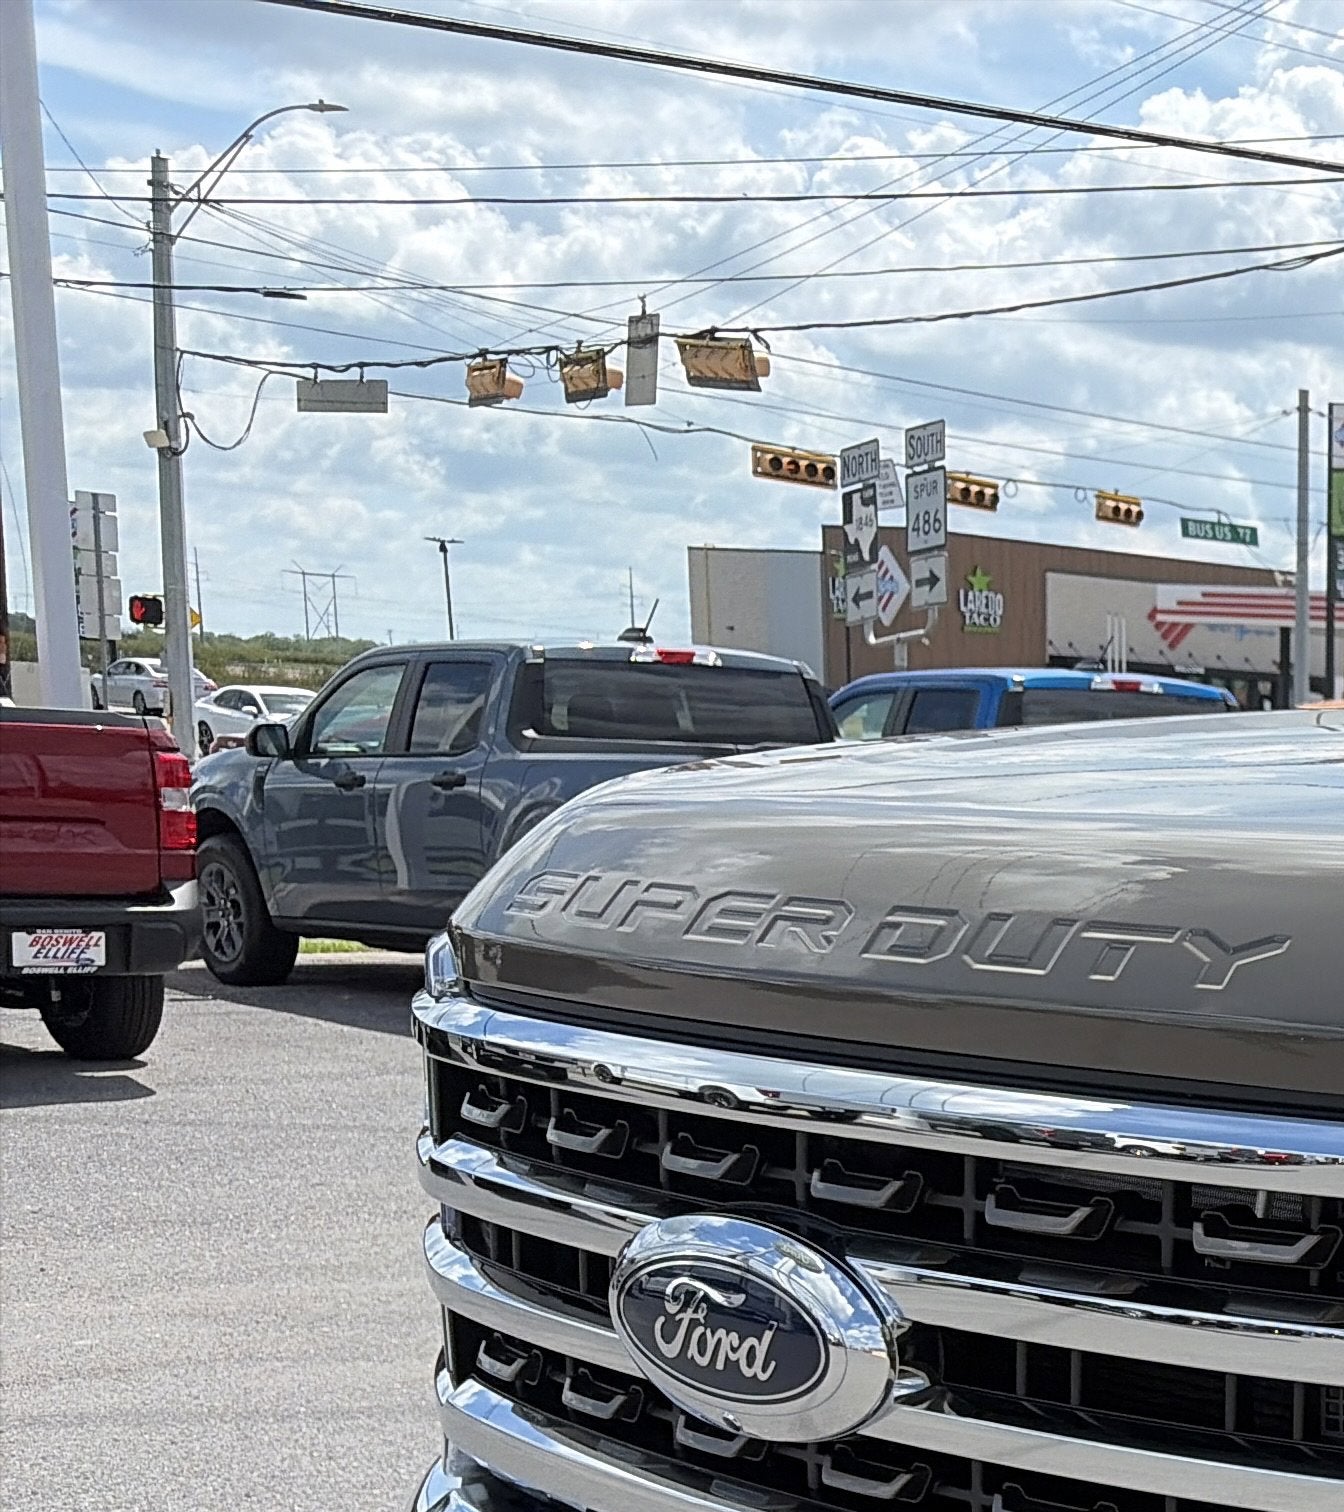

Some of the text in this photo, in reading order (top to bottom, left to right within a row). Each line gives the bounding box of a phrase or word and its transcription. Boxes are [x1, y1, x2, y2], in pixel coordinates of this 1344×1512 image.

[908, 432, 942, 460] SOUTH
[842, 450, 878, 479] NORTH
[913, 480, 939, 500] SPUR
[912, 508, 942, 537] 486
[1187, 521, 1252, 542] BUS US 77
[965, 613, 1001, 627] TACO
[505, 869, 1293, 991] SUPER DUTY
[28, 935, 102, 948] BOSWELL
[32, 947, 90, 959] ELLIFF
[21, 966, 98, 975] BOSWELL ELLIFF
[654, 1275, 778, 1382] Ford
